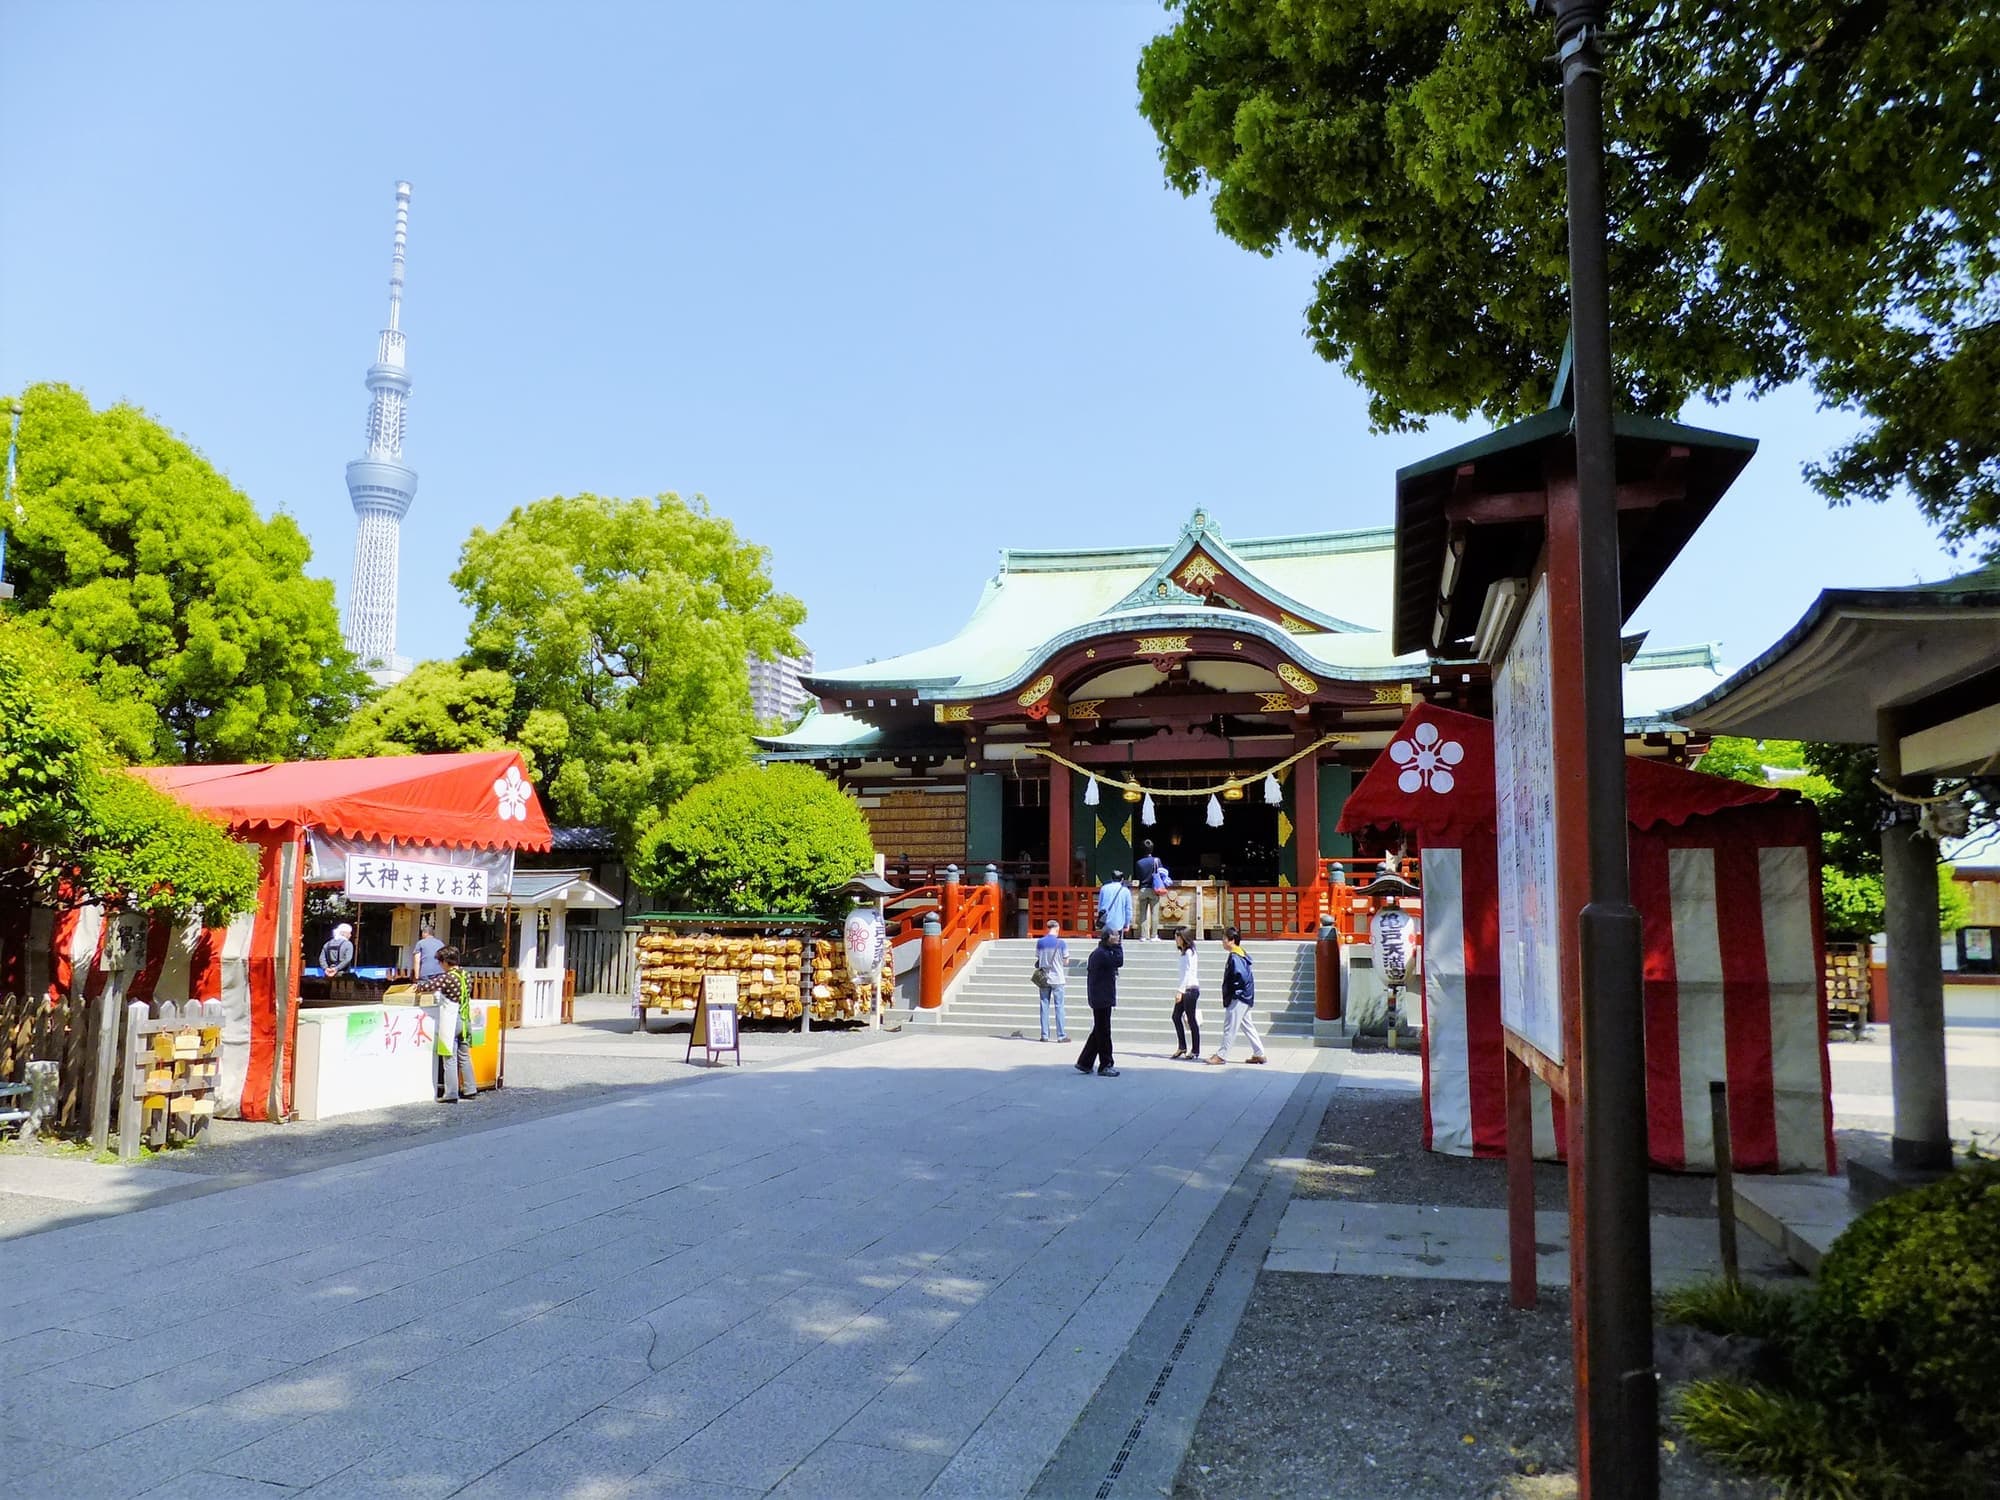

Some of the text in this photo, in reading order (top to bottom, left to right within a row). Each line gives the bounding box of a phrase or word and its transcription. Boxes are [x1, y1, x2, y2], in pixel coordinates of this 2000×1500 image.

[357, 862, 482, 897] 天神さまとお茶
[1380, 913, 1406, 980] 亀戸天満宮
